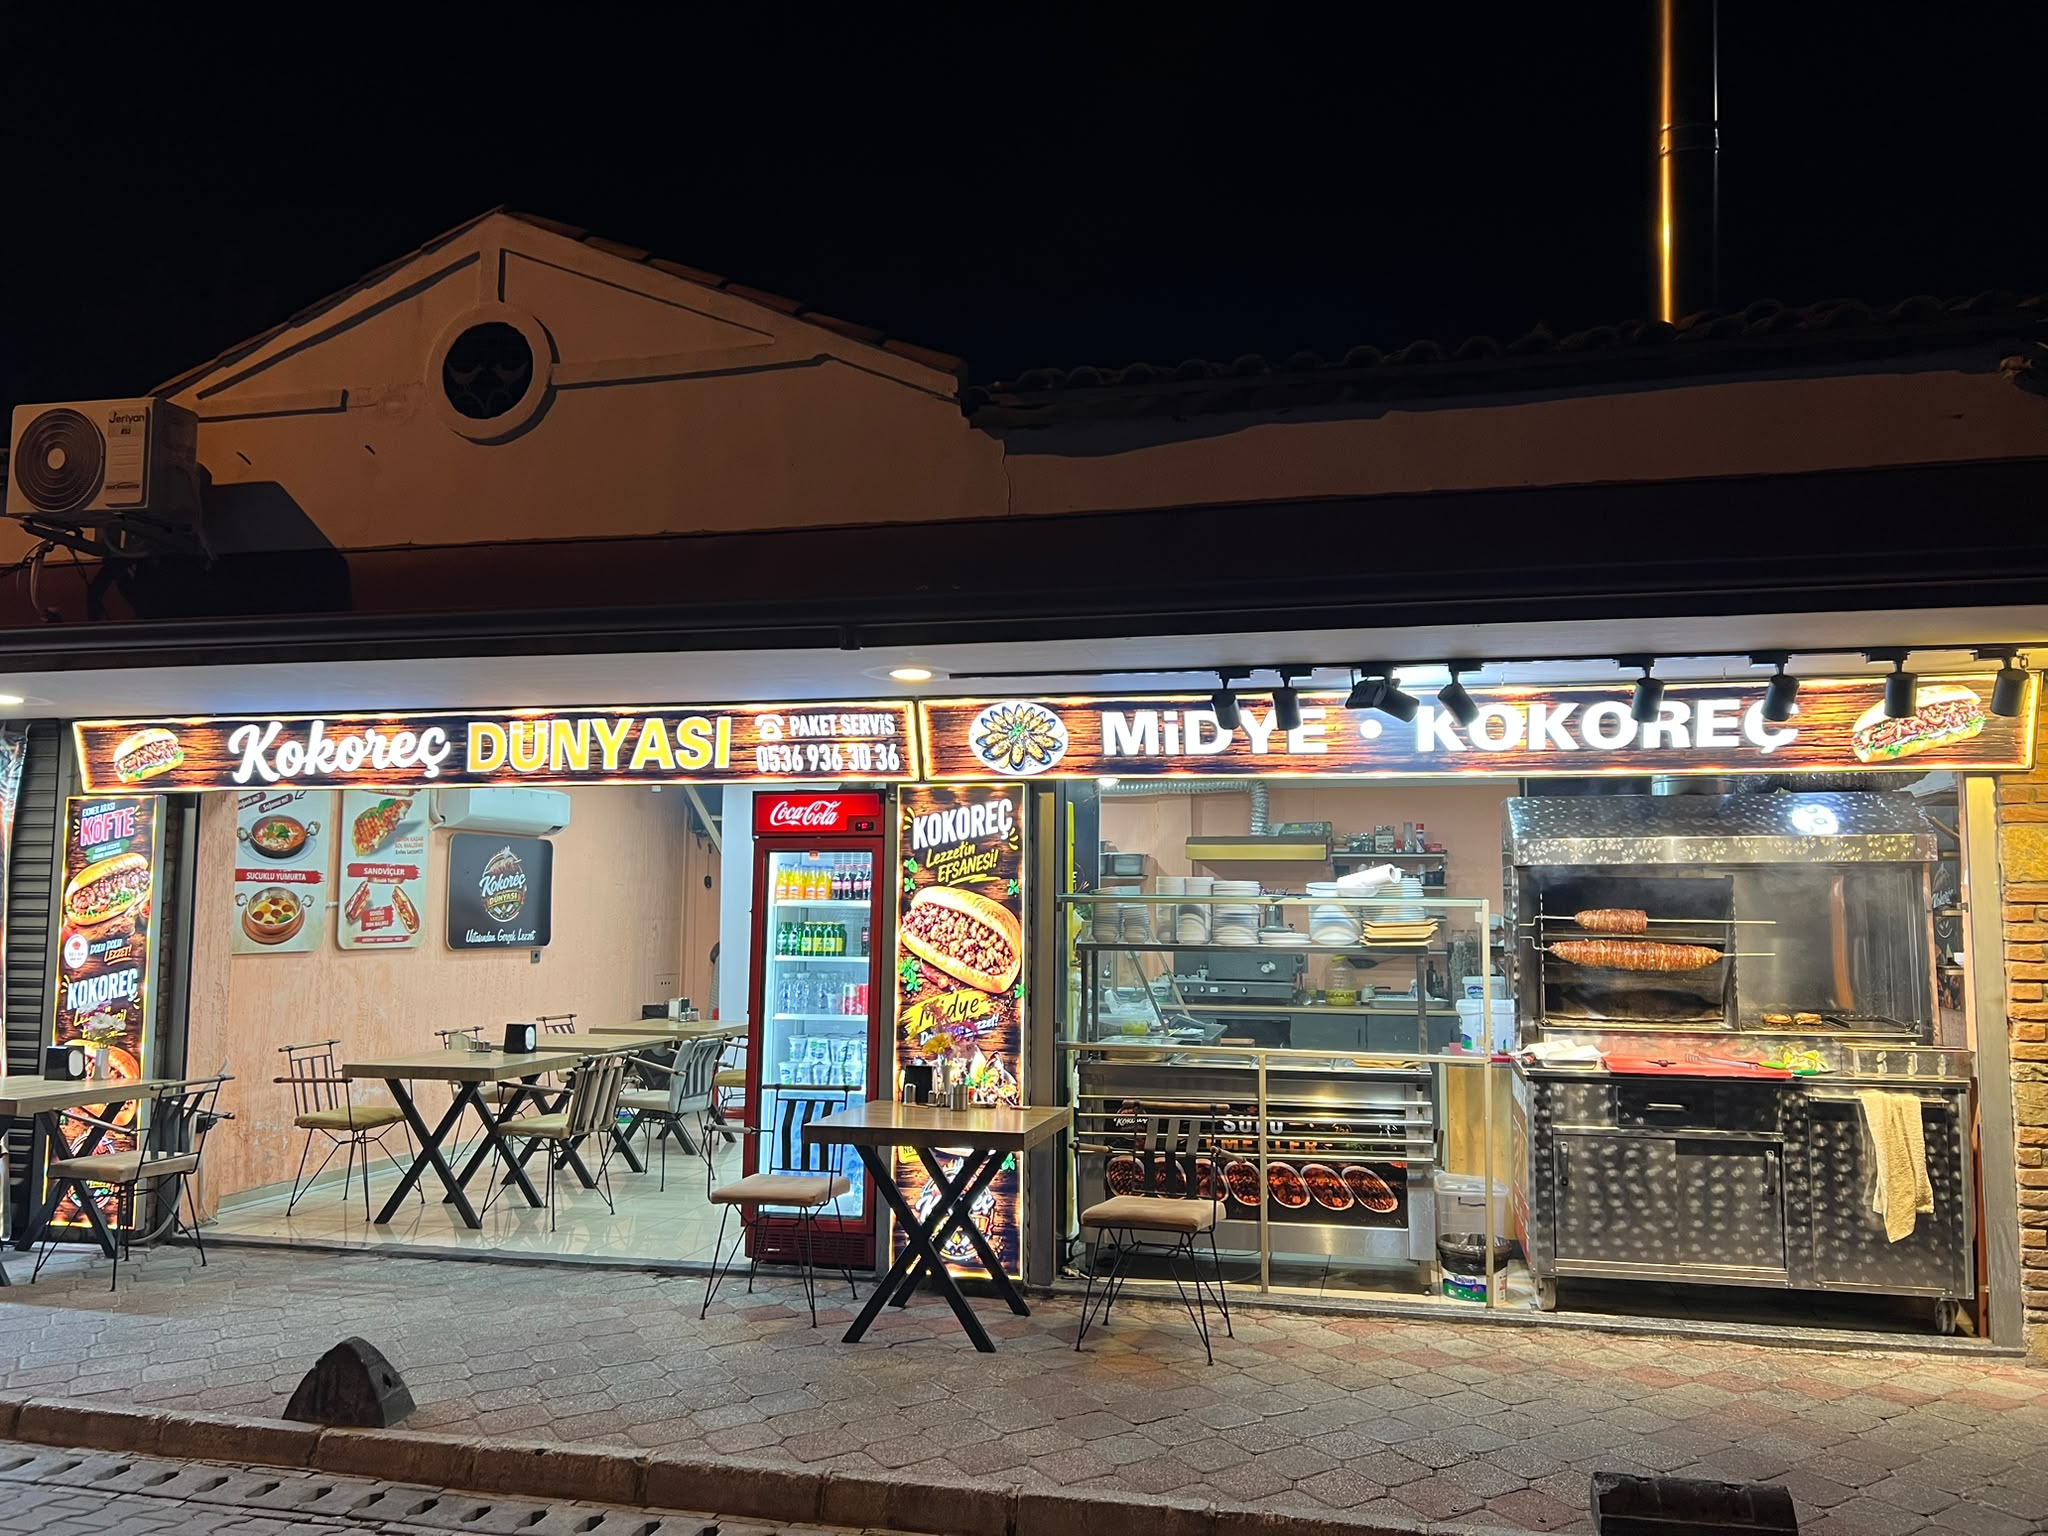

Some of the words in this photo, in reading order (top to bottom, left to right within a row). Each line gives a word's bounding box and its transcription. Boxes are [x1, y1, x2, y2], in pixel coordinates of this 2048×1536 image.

[789, 714, 837, 737] PAKET
[1417, 698, 1800, 754] KOKOREÇ
[228, 720, 450, 784] Kokoreç
[467, 716, 732, 772] DÜNYASI
[756, 745, 804, 772] 0536
[807, 744, 843, 771] 936
[846, 743, 871, 771] 30
[874, 744, 900, 771] 36
[80, 807, 135, 847] KÖFTE
[770, 800, 842, 826] Coca-Cola
[913, 799, 1013, 850] KOKOREÇ
[926, 841, 976, 868] Lezzetin
[246, 871, 275, 880] SUCUKLU
[276, 872, 306, 881] YUMURTA
[479, 873, 526, 897] Kokoreç
[104, 944, 132, 962] LEZZET!
[67, 968, 138, 1010] KOKOREÇ
[919, 994, 980, 1026] Mdye
